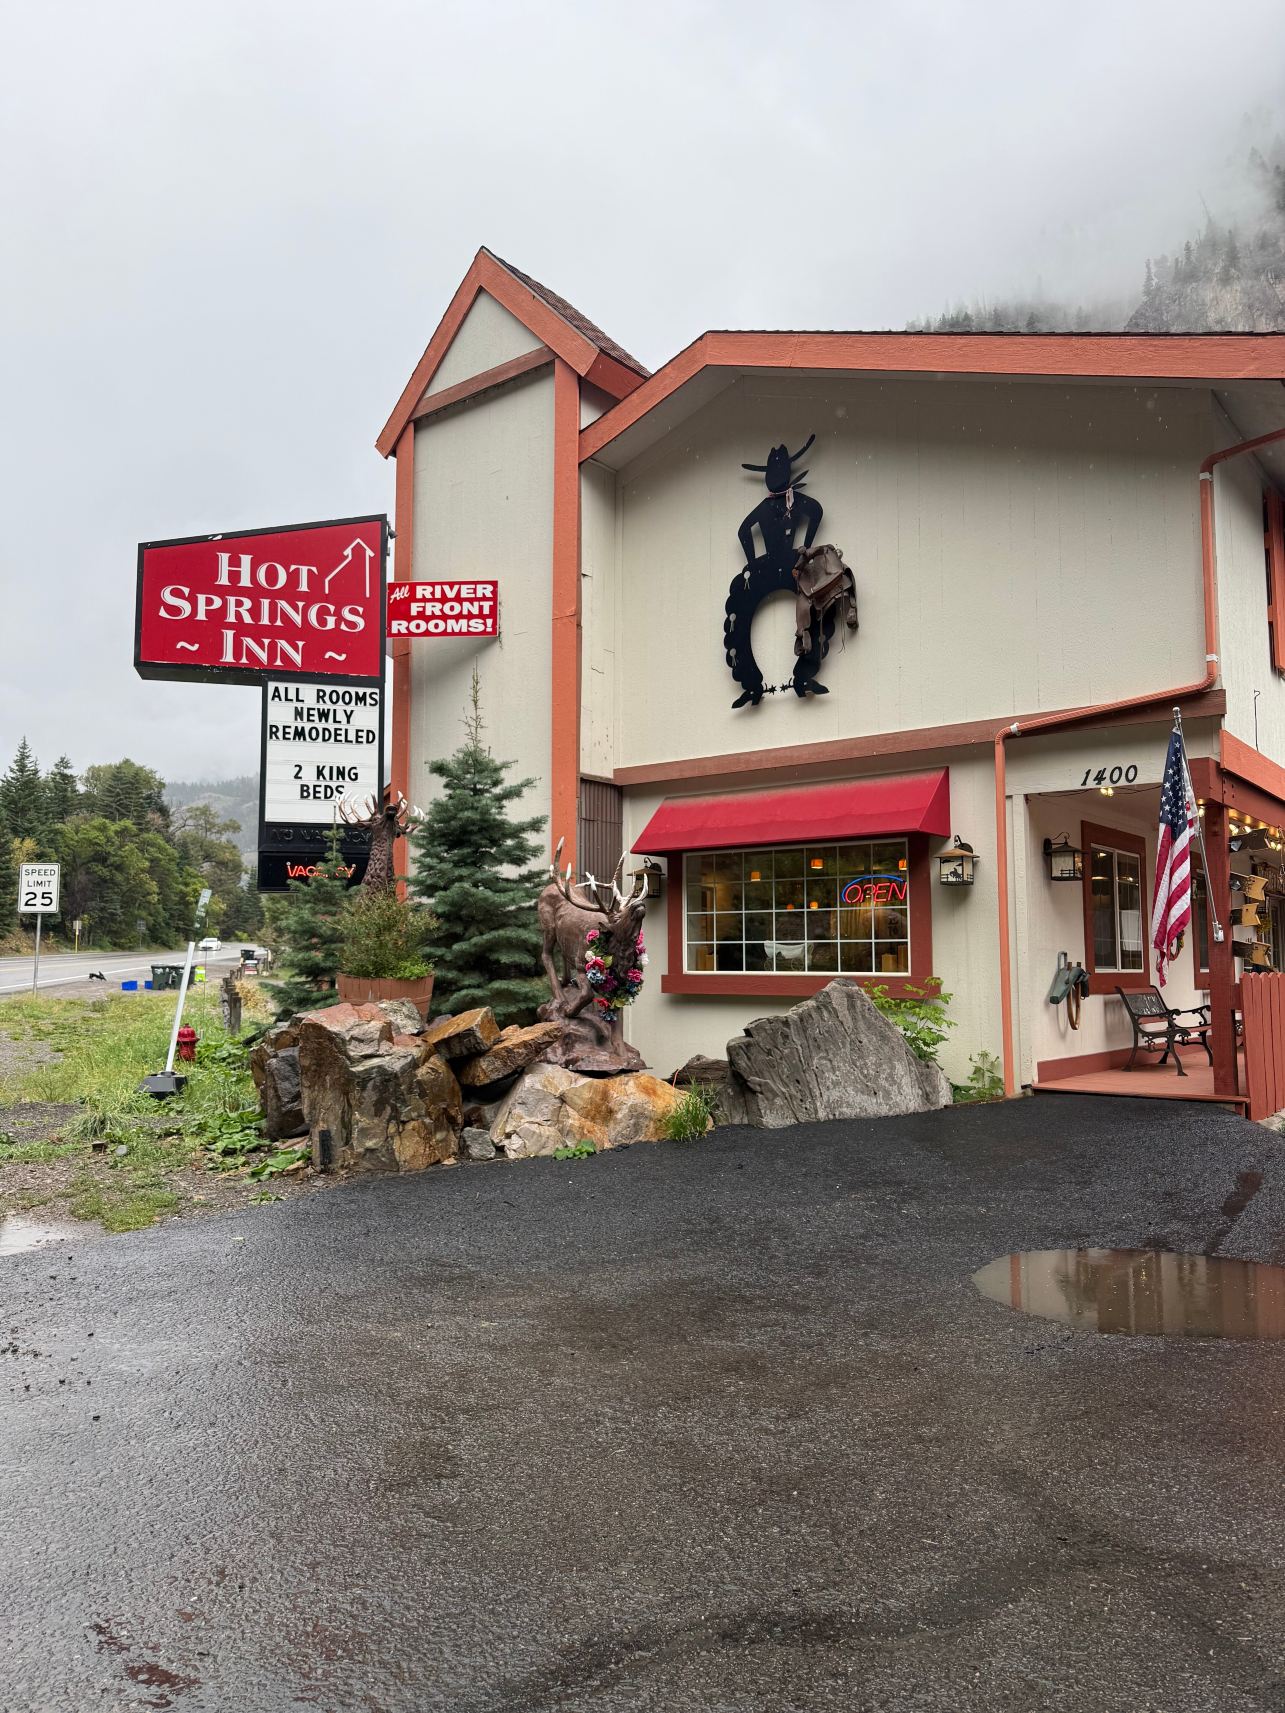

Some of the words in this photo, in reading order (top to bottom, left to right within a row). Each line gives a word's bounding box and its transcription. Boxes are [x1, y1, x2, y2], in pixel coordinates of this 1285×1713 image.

[214, 552, 318, 592] HOT
[390, 584, 410, 604] All
[416, 584, 494, 599] RIVER
[159, 585, 365, 632] SPRINGS
[410, 601, 494, 616] FRONT
[391, 618, 494, 634] ROOMS!
[219, 629, 306, 667] INN
[271, 686, 304, 703] ALL
[316, 688, 379, 707] ROOMS
[294, 706, 354, 724] NEWLY
[269, 724, 376, 744] REMODELED
[293, 764, 303, 780] 2
[316, 765, 359, 782] KING
[1081, 765, 1138, 786] 1400
[300, 784, 345, 800] BEDS
[24, 868, 56, 877] SPEED
[27, 880, 53, 888] LIMIT
[845, 882, 907, 903] OPEN
[24, 891, 53, 906] 25
